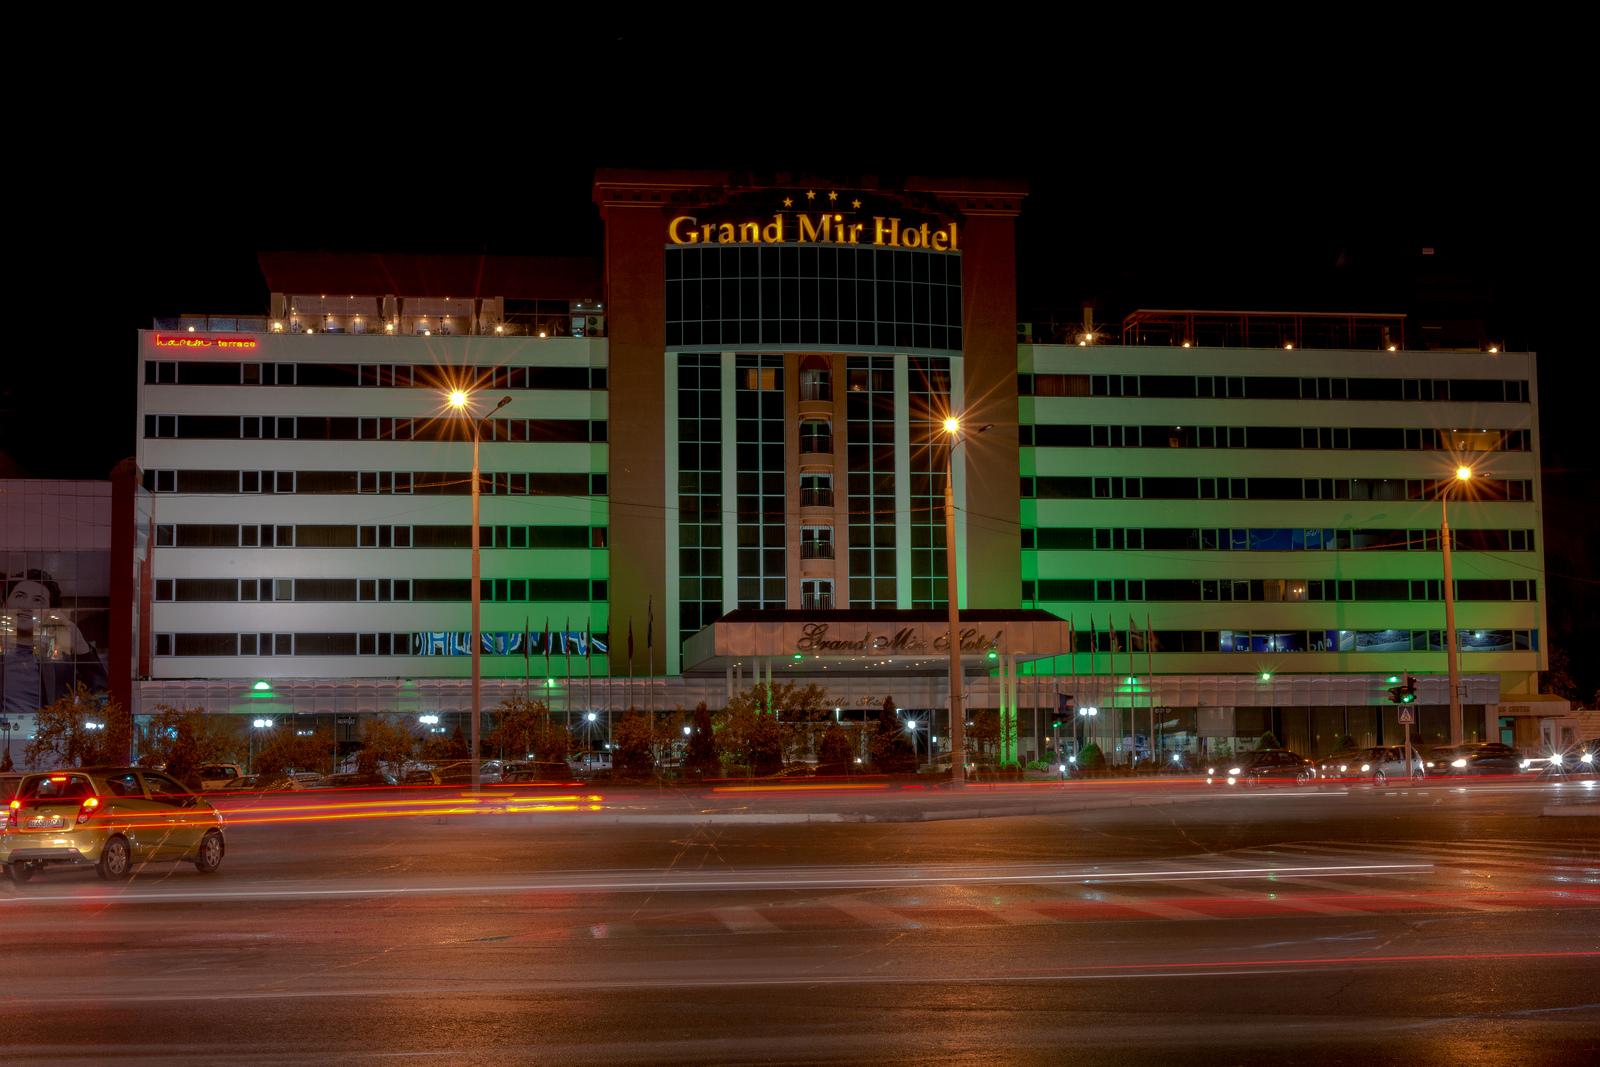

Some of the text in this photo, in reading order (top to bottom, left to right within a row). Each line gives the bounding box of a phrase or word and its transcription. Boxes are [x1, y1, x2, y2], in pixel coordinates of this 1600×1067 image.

[668, 213, 959, 251] Grand Mir Hotel
[217, 339, 256, 349] terrace
[797, 623, 872, 650] Grand
